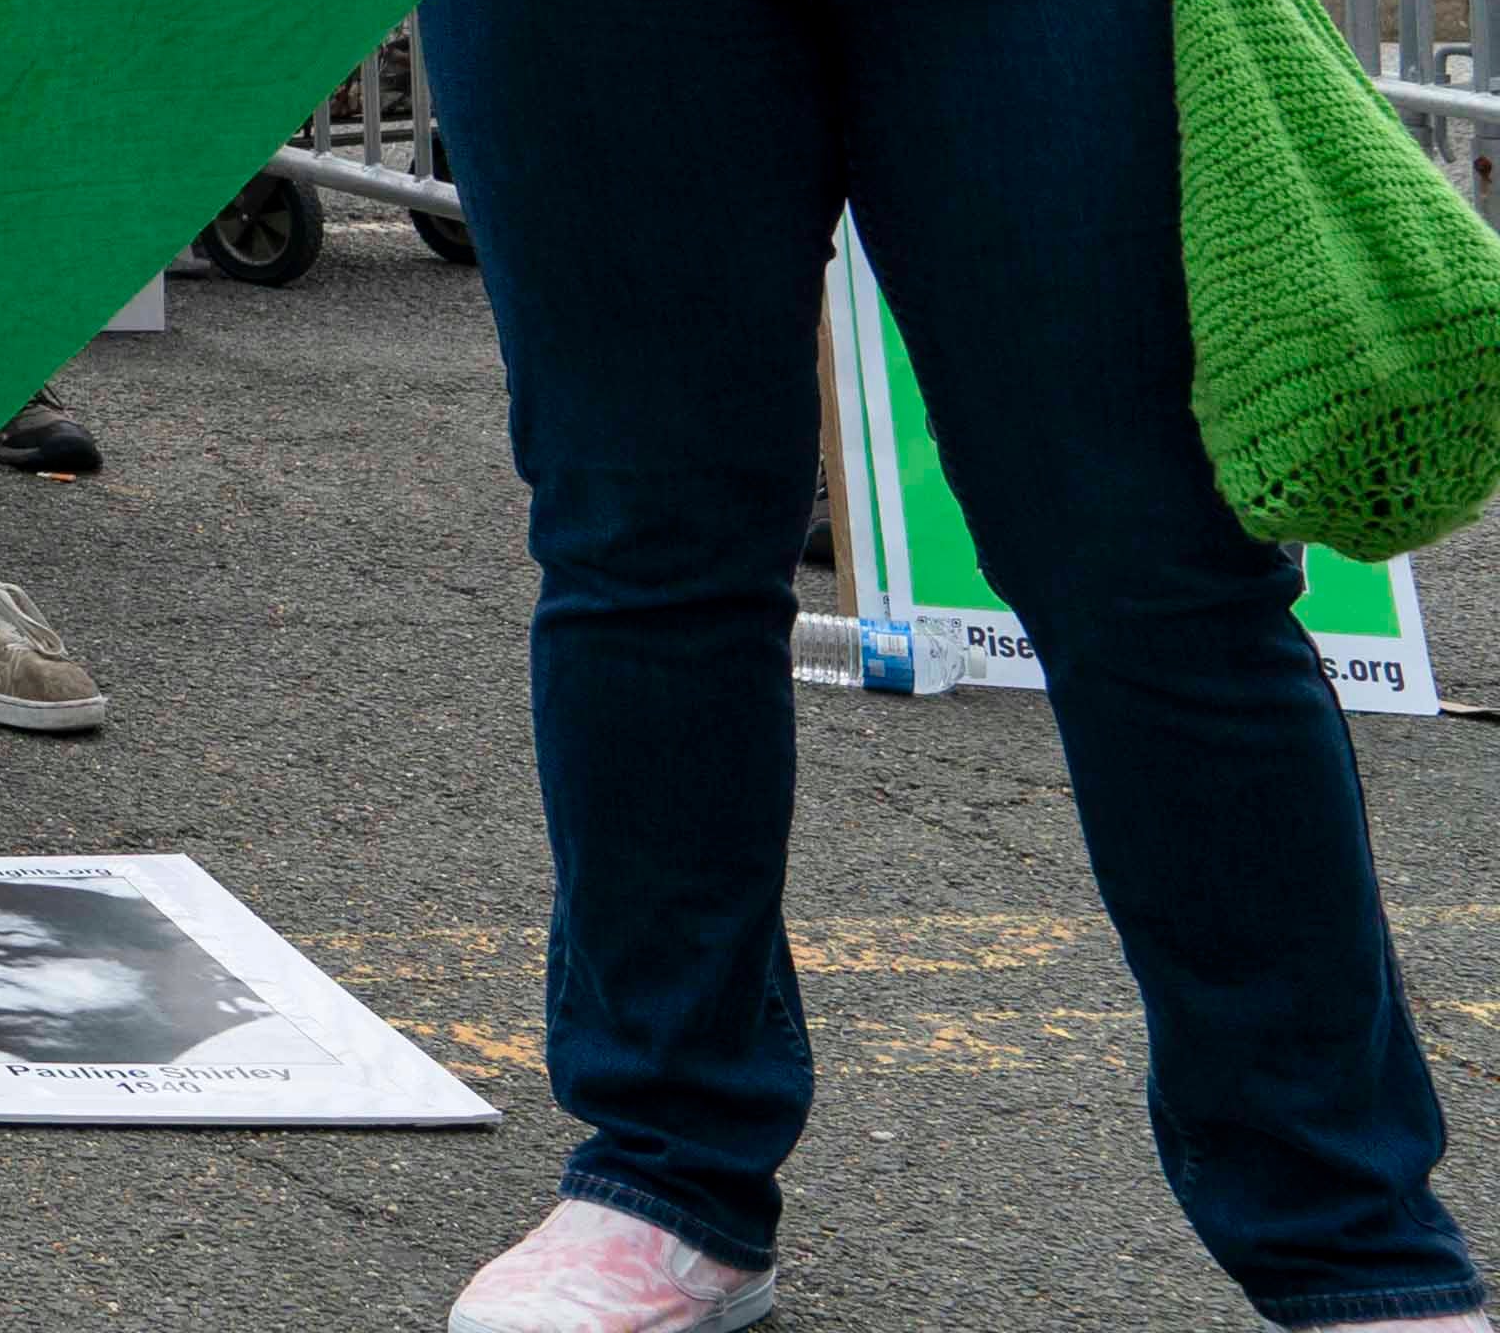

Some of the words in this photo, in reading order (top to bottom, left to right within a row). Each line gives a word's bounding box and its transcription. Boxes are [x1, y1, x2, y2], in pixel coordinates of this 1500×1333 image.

[5, 1064, 151, 1079] Pauline
[157, 1066, 292, 1081] Shirley
[116, 1081, 202, 1094] 1940
